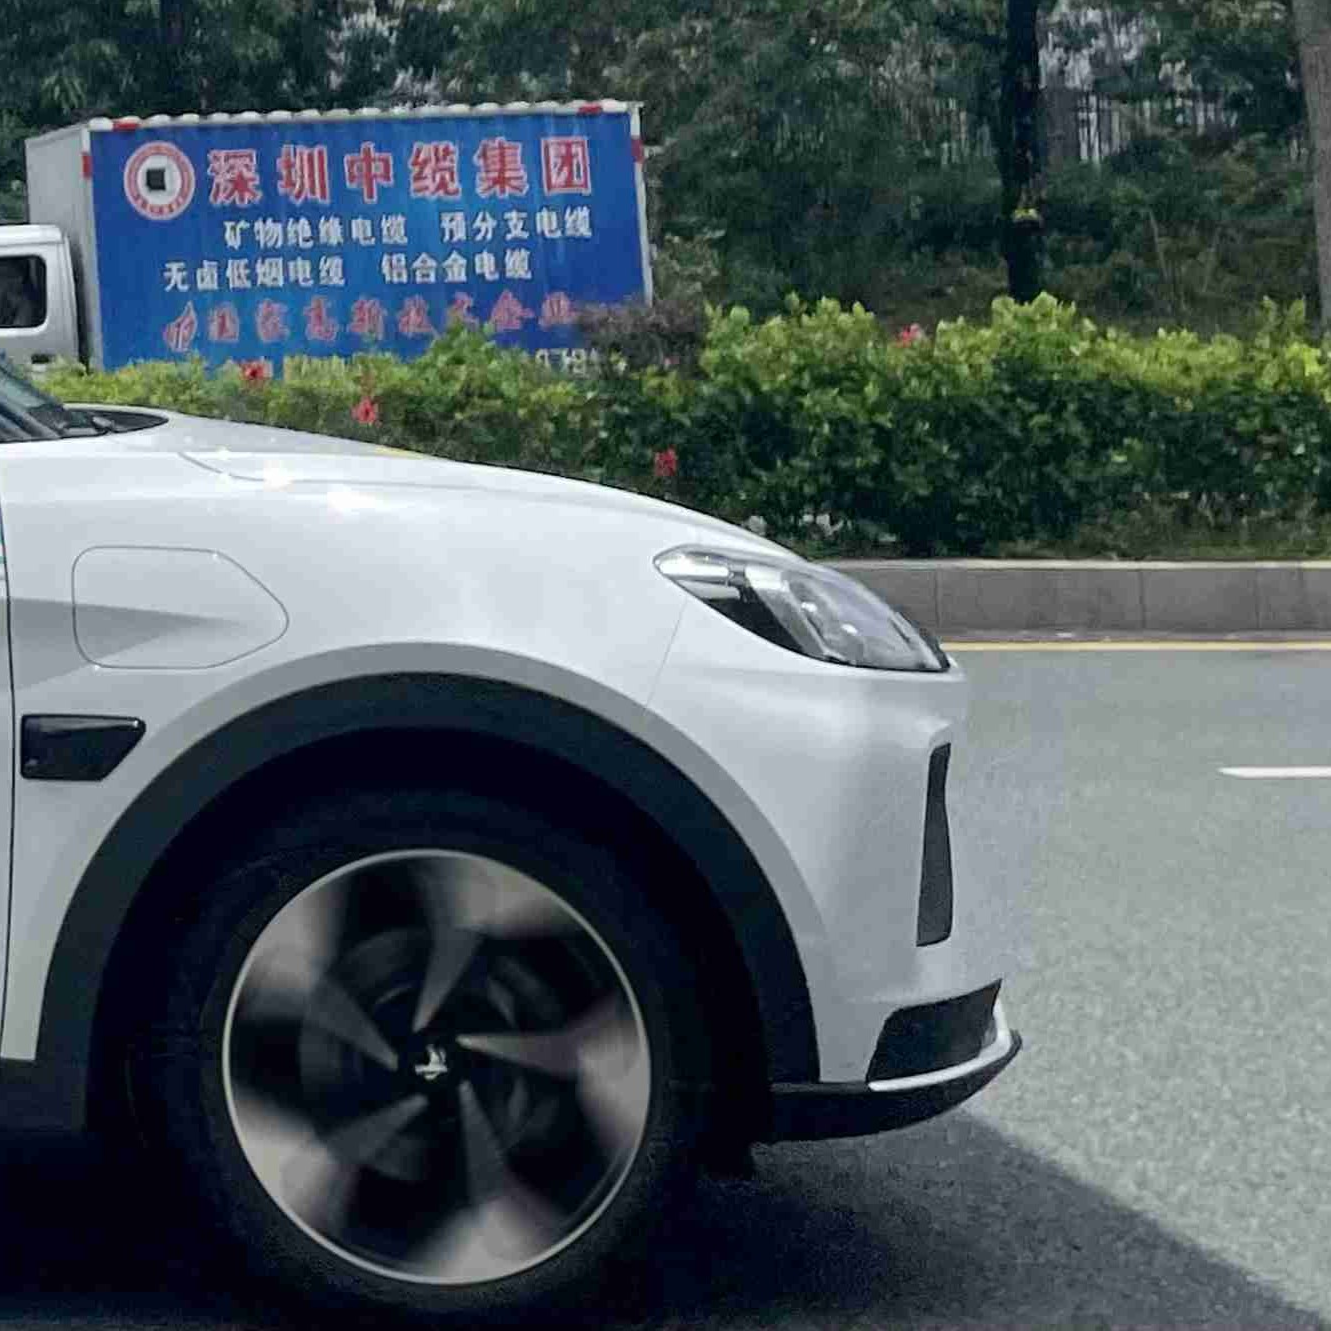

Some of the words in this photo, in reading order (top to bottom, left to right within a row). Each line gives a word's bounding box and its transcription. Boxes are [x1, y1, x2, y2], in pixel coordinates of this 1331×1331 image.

[206, 135, 593, 206] 深圳中缆集团
[223, 213, 408, 249] 矿物绝缘电缆
[440, 205, 592, 243] 预分支电缆
[163, 255, 345, 293] 无卤低烟电缆
[381, 247, 532, 284] 铝合金电缆
